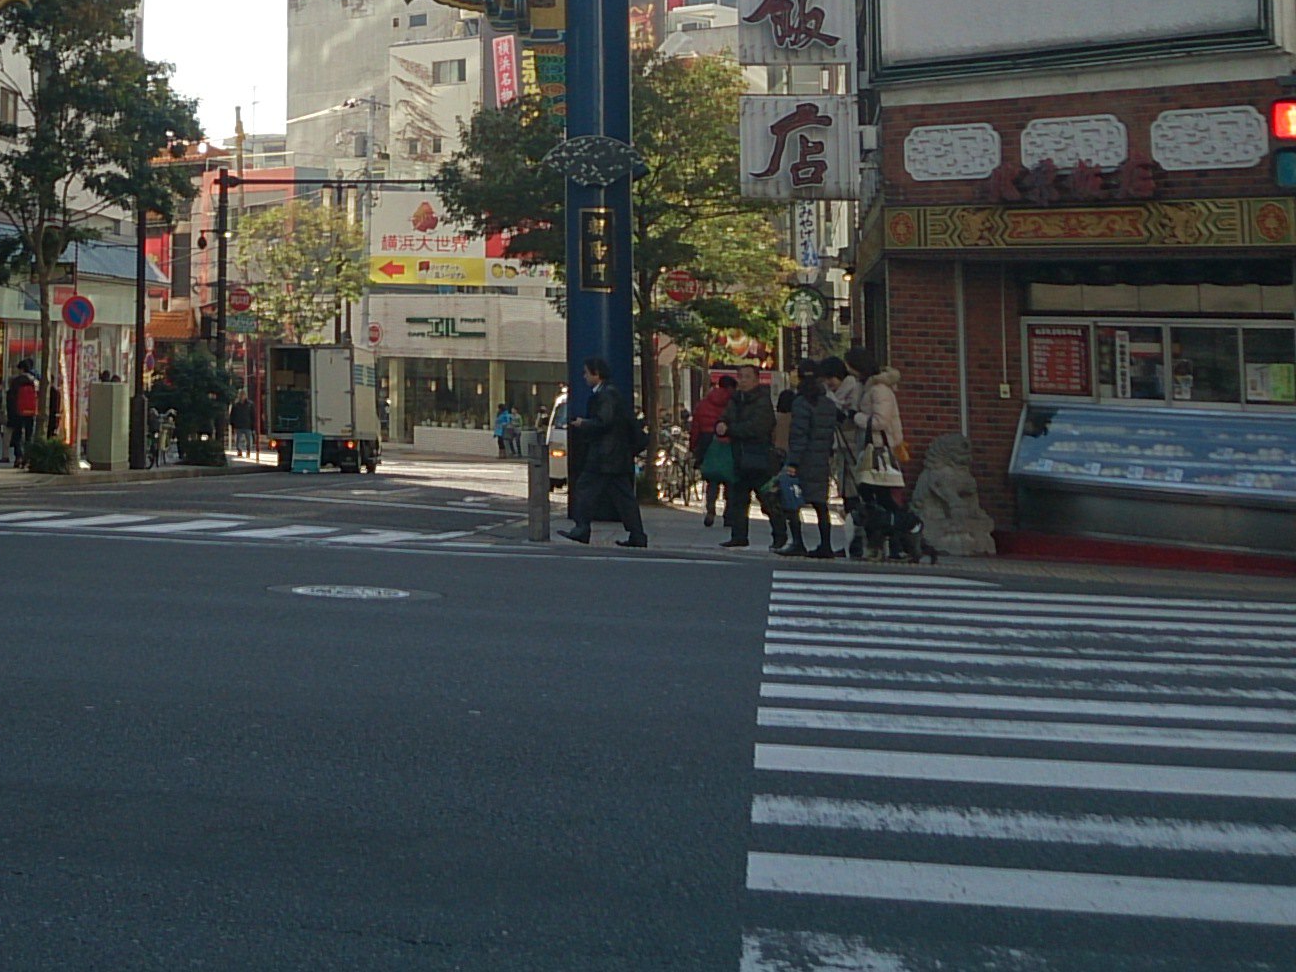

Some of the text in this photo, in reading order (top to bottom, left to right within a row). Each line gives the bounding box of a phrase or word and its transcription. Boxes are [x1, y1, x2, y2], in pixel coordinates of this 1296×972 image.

[381, 234, 468, 253] 横浜大世界
